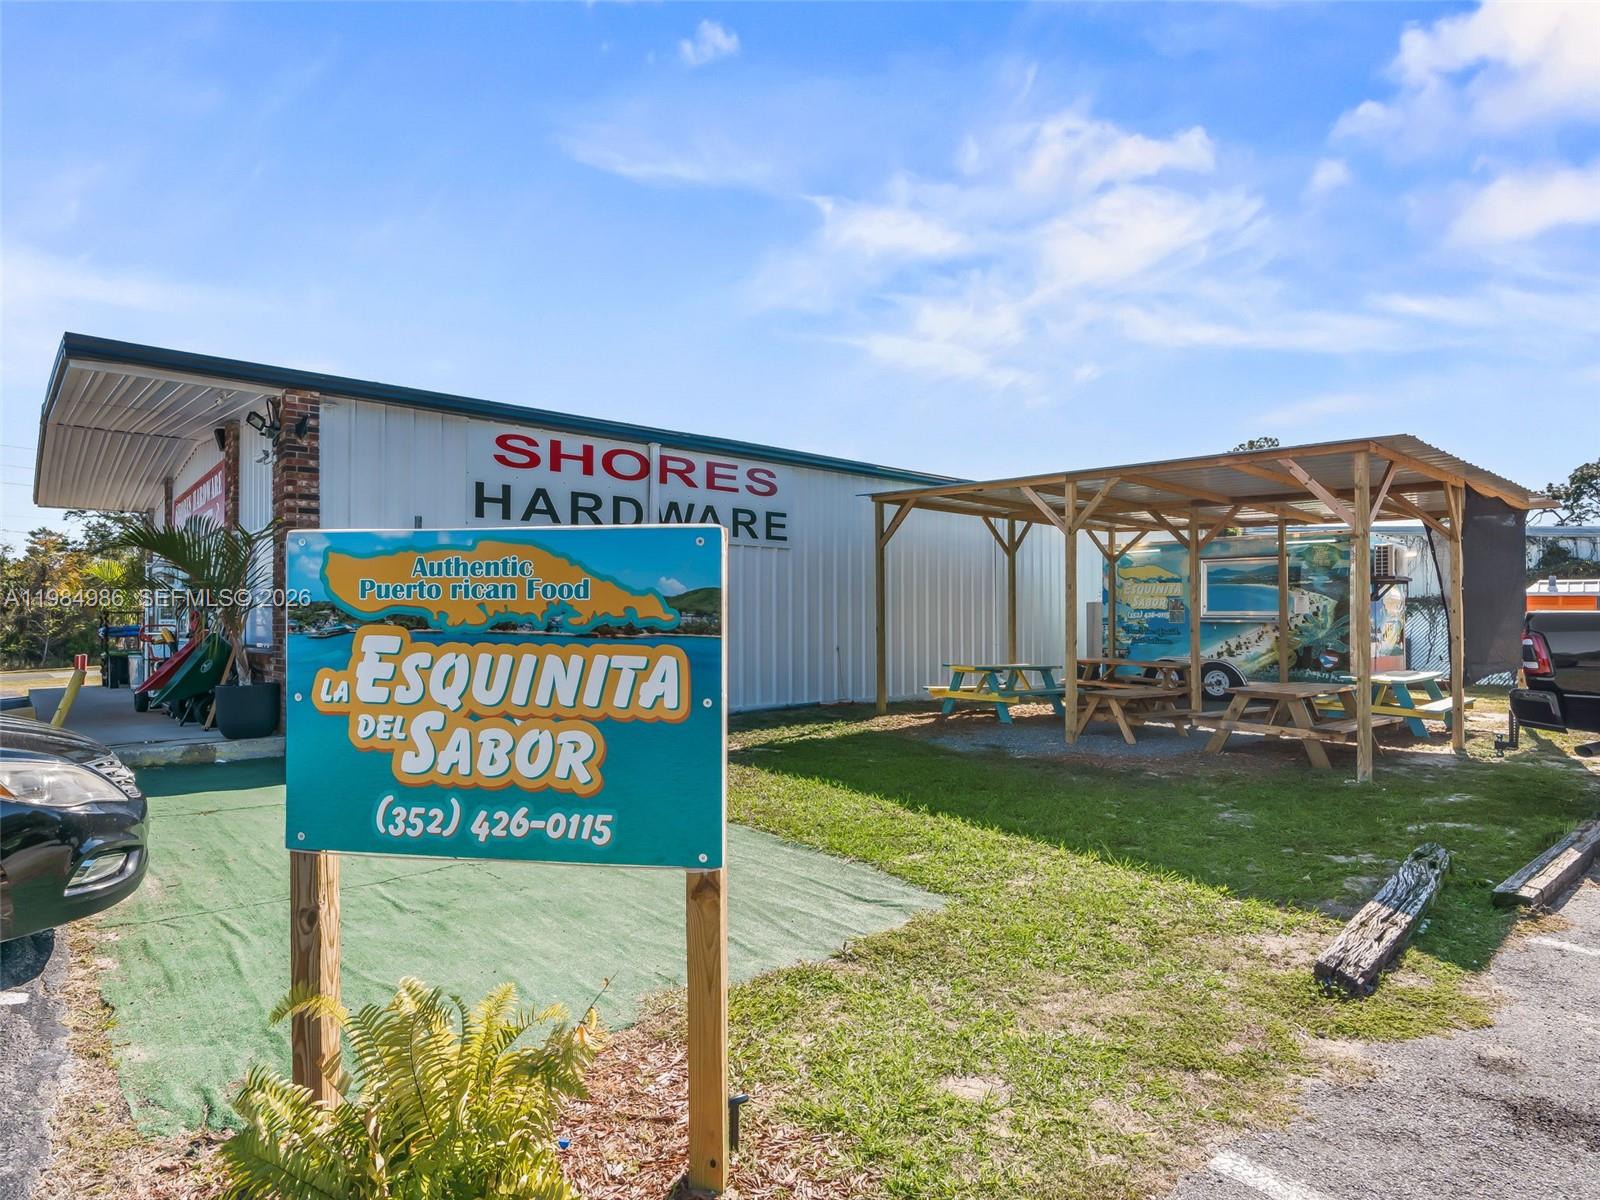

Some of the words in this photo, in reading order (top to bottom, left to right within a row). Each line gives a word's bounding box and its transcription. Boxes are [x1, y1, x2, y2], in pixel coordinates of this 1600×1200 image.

[493, 433, 779, 497] SHORES
[474, 481, 788, 541] HARDWARE
[358, 578, 442, 600] Puerto
[450, 577, 517, 600] rican
[526, 577, 591, 600] Food
[411, 555, 534, 577] Authentic
[320, 678, 349, 703] LA
[356, 635, 679, 711] ESQUINITA
[357, 714, 406, 740] DEL
[376, 795, 461, 837] (352)
[470, 807, 613, 846] 426-0115
